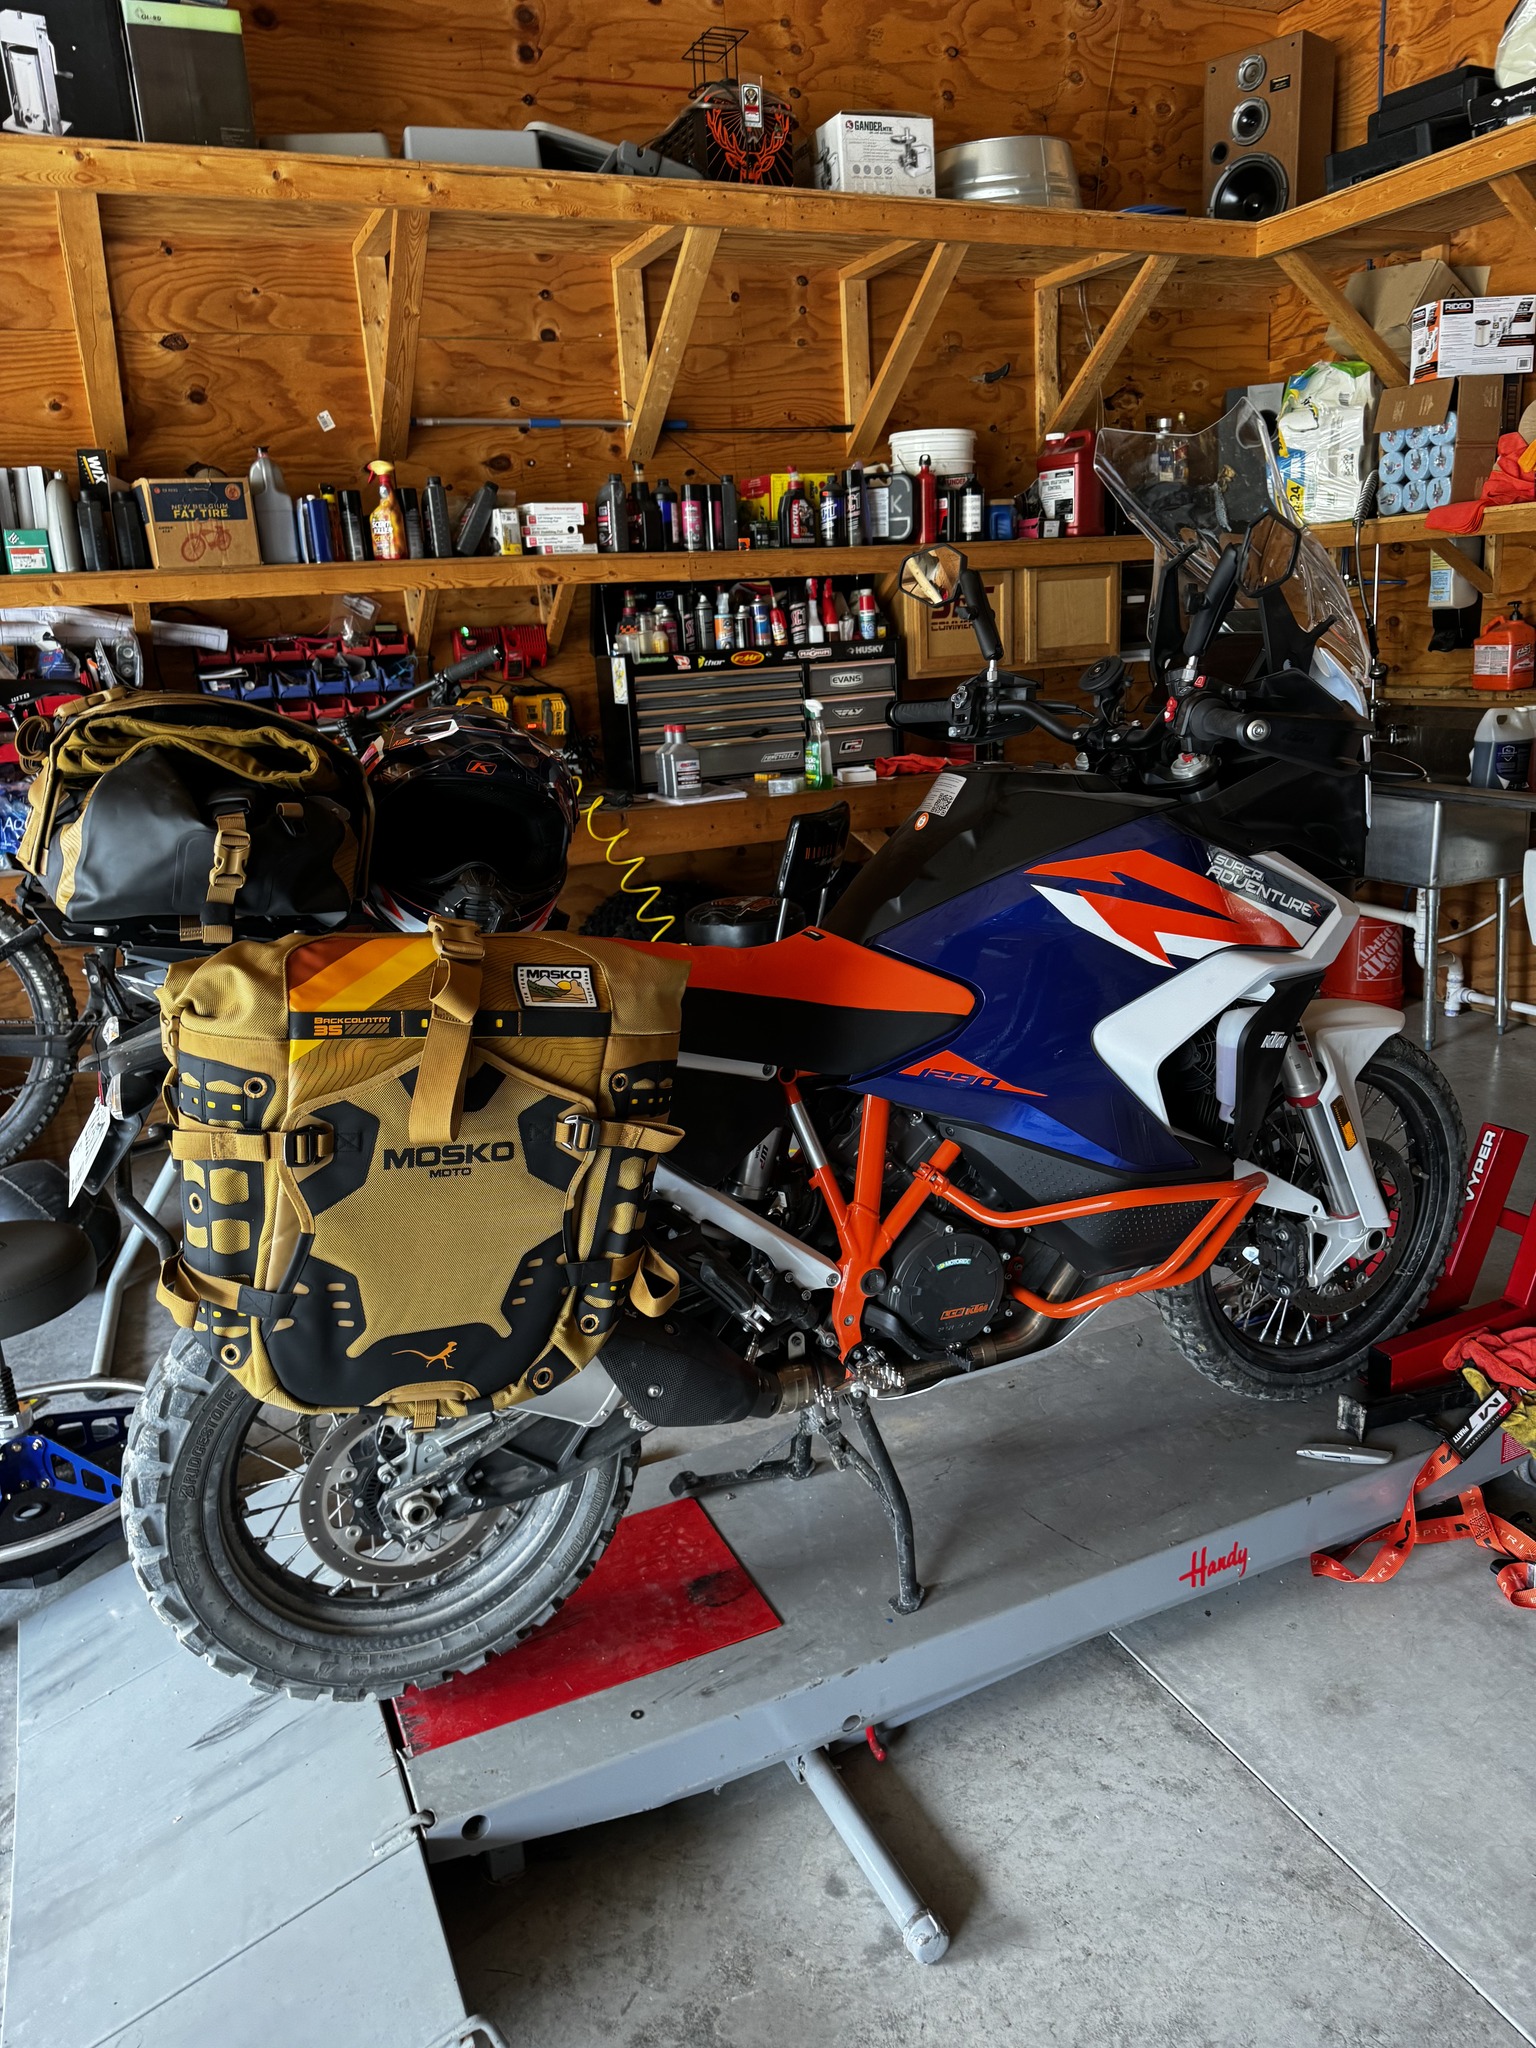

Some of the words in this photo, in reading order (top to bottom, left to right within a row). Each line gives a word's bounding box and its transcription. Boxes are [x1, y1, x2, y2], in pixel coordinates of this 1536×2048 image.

[854, 120, 882, 132] GANDER
[87, 455, 108, 484] WIX
[171, 503, 190, 511] NEW
[192, 502, 229, 510] BELGIUM
[173, 509, 196, 519] FAT
[199, 508, 229, 518] TIRE
[792, 503, 800, 536] MOTUL
[856, 645, 884, 654] HUSKY
[832, 674, 862, 684] EVANS
[1212, 854, 1264, 881] SUPER
[1205, 865, 1314, 918] ADVENTURE
[526, 969, 582, 979] MOSKO
[313, 1024, 343, 1037] 35
[1260, 1030, 1289, 1049] KTM
[383, 1141, 515, 1170] MOSKO
[1455, 1129, 1497, 1201] VYPER
[429, 1166, 472, 1179] MOTO
[1297, 1244, 1305, 1278] brembo
[178, 1388, 238, 1500] BRIDGESTONE
[1452, 1425, 1470, 1444] PHATTY
[1178, 1541, 1248, 1588] Handy
